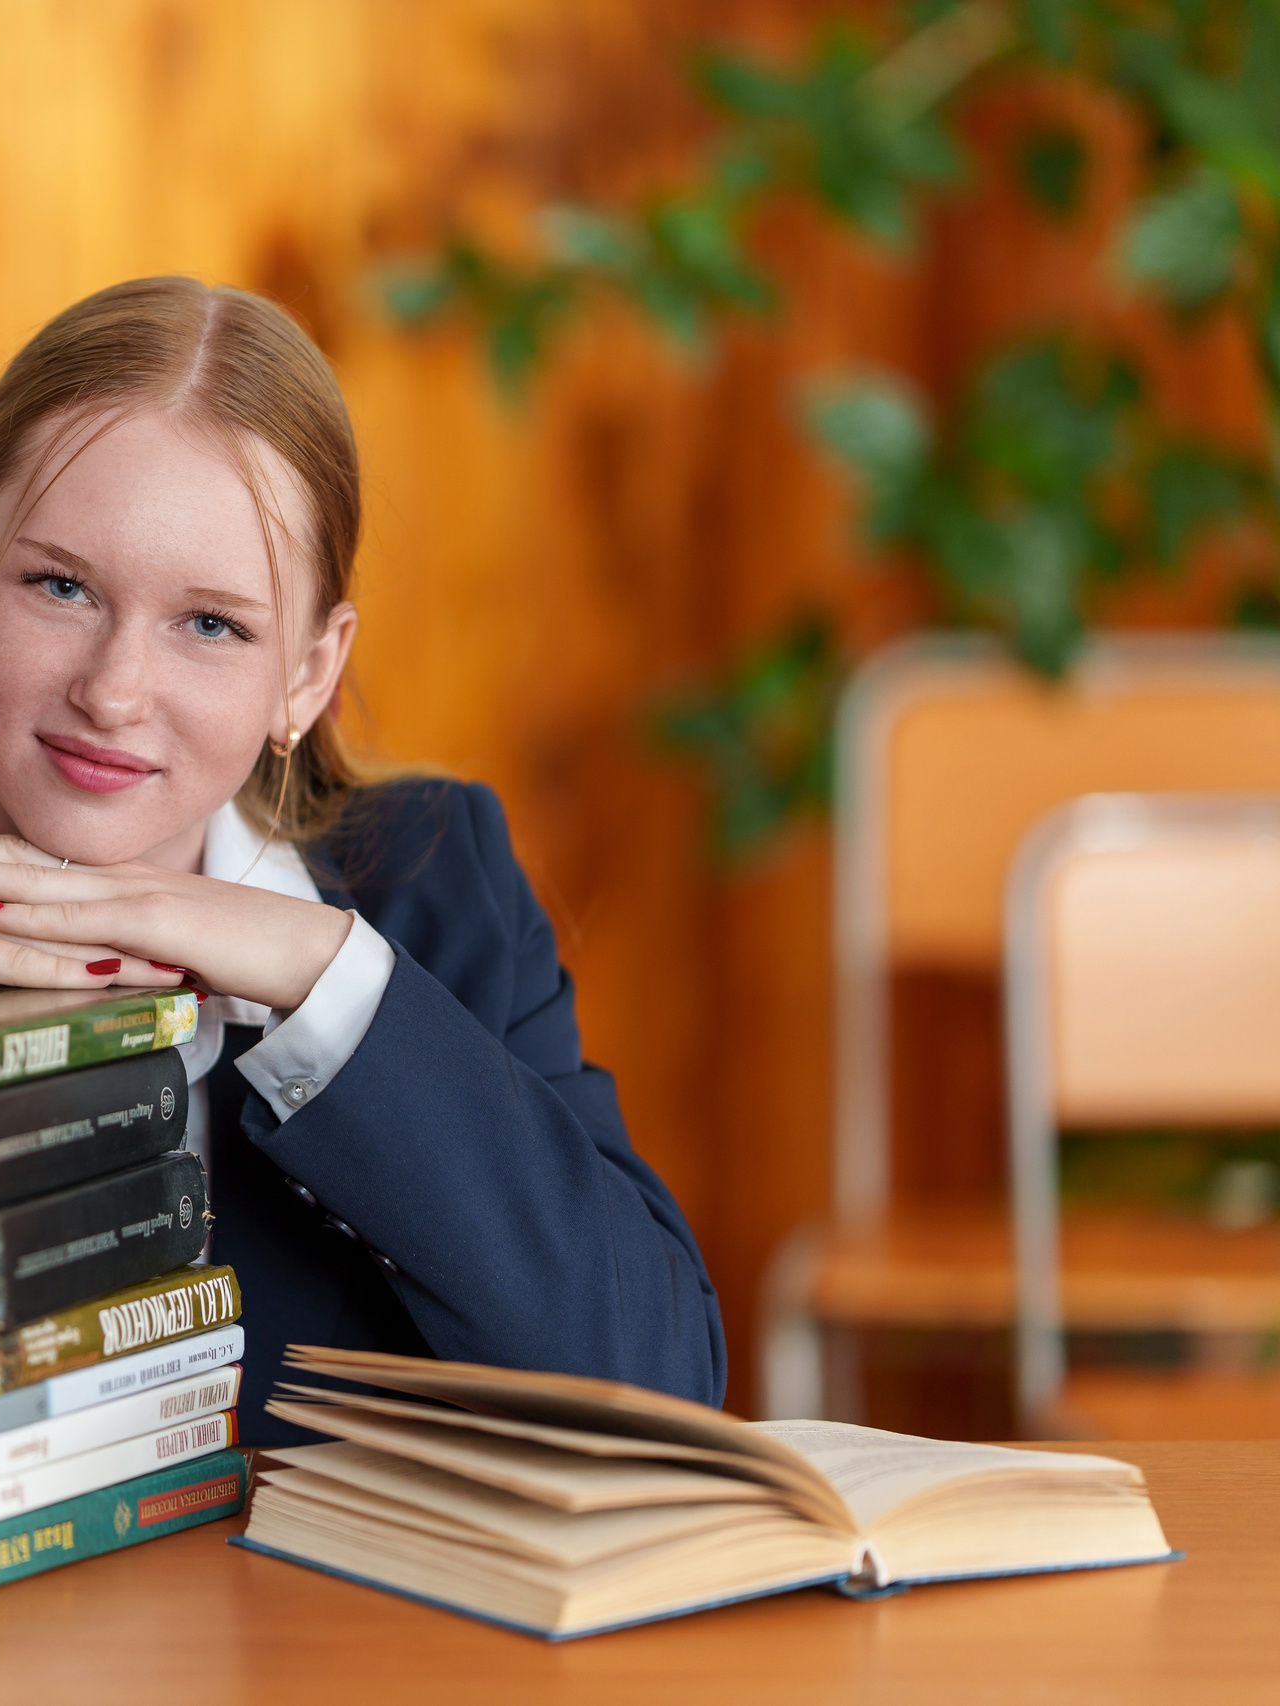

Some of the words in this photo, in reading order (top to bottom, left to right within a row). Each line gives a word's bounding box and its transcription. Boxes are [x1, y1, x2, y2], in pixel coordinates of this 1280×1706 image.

[99, 1286, 194, 1356] ЛЕРМОНТОВ
[188, 1347, 217, 1363] Пушкин
[140, 1359, 181, 1384] ЕВГЕНИЙ
[160, 1388, 196, 1419] ЦВЕТАЕВА
[199, 1380, 231, 1408] МАРИНА
[156, 1428, 188, 1459] АНДРЕЕВ
[190, 1419, 222, 1449] ЛЕОНИД
[141, 1497, 178, 1520] ПОЭЗИИ
[180, 1481, 236, 1508] БИБЛИОТЕКА
[34, 1520, 74, 1551] Иван
